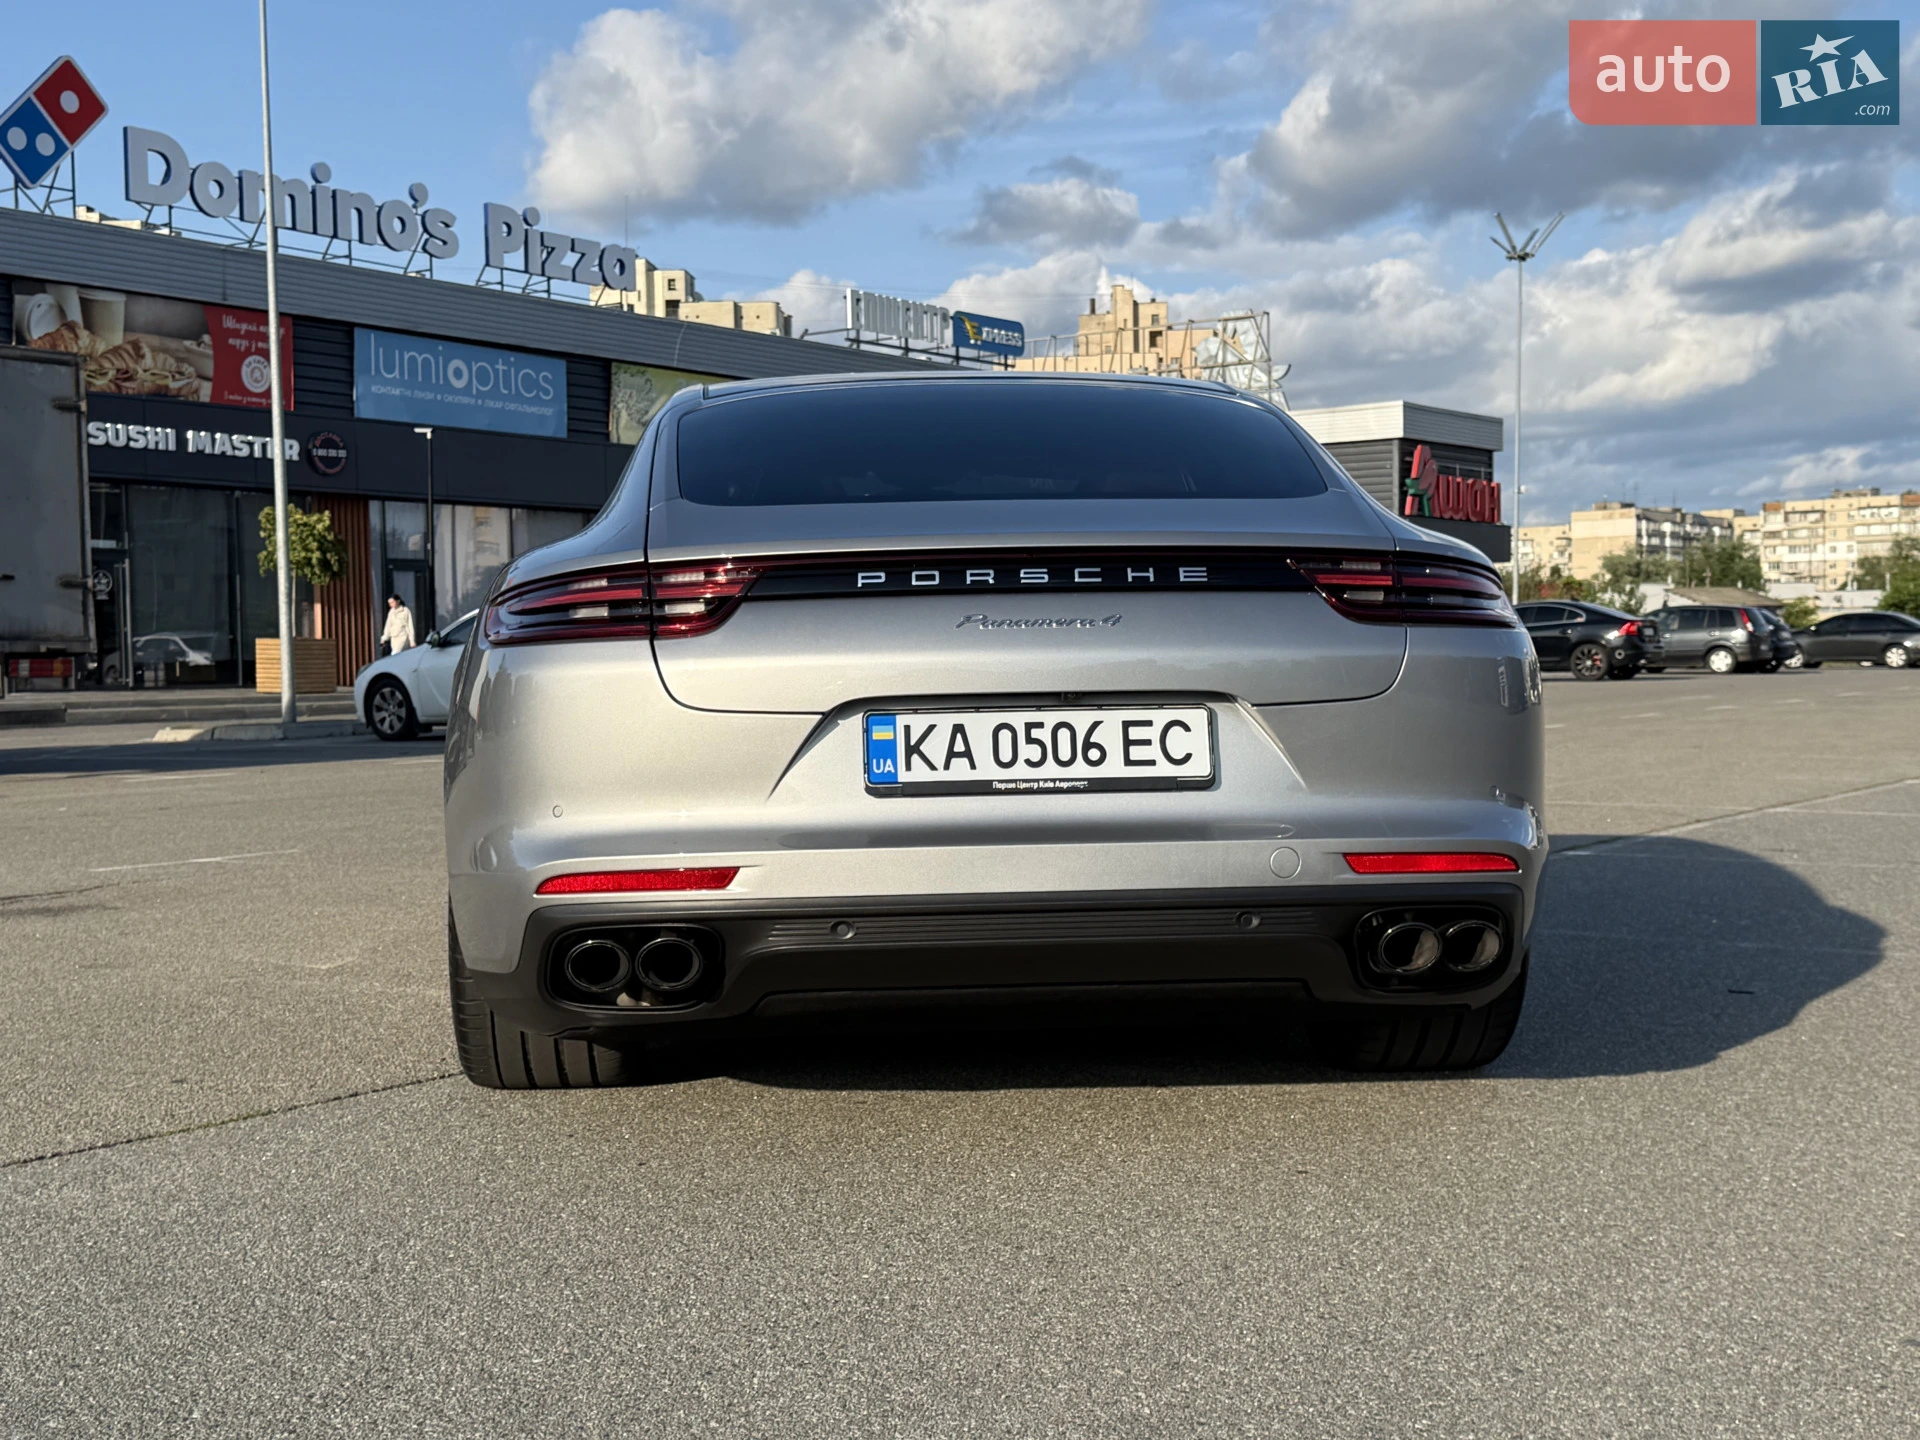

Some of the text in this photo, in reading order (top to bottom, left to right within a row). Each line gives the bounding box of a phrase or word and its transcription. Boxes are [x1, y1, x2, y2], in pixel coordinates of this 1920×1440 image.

[123, 126, 637, 290] Domino's Pizza
[371, 333, 554, 400] lumioptics
[87, 421, 176, 451] SUSHI
[857, 567, 1208, 587] PORSCHE
[954, 613, 1122, 630] Panamera 4
[903, 719, 1193, 772] KA 0506 EC
[873, 759, 895, 774] UA
[1017, 781, 1038, 790] Центр
